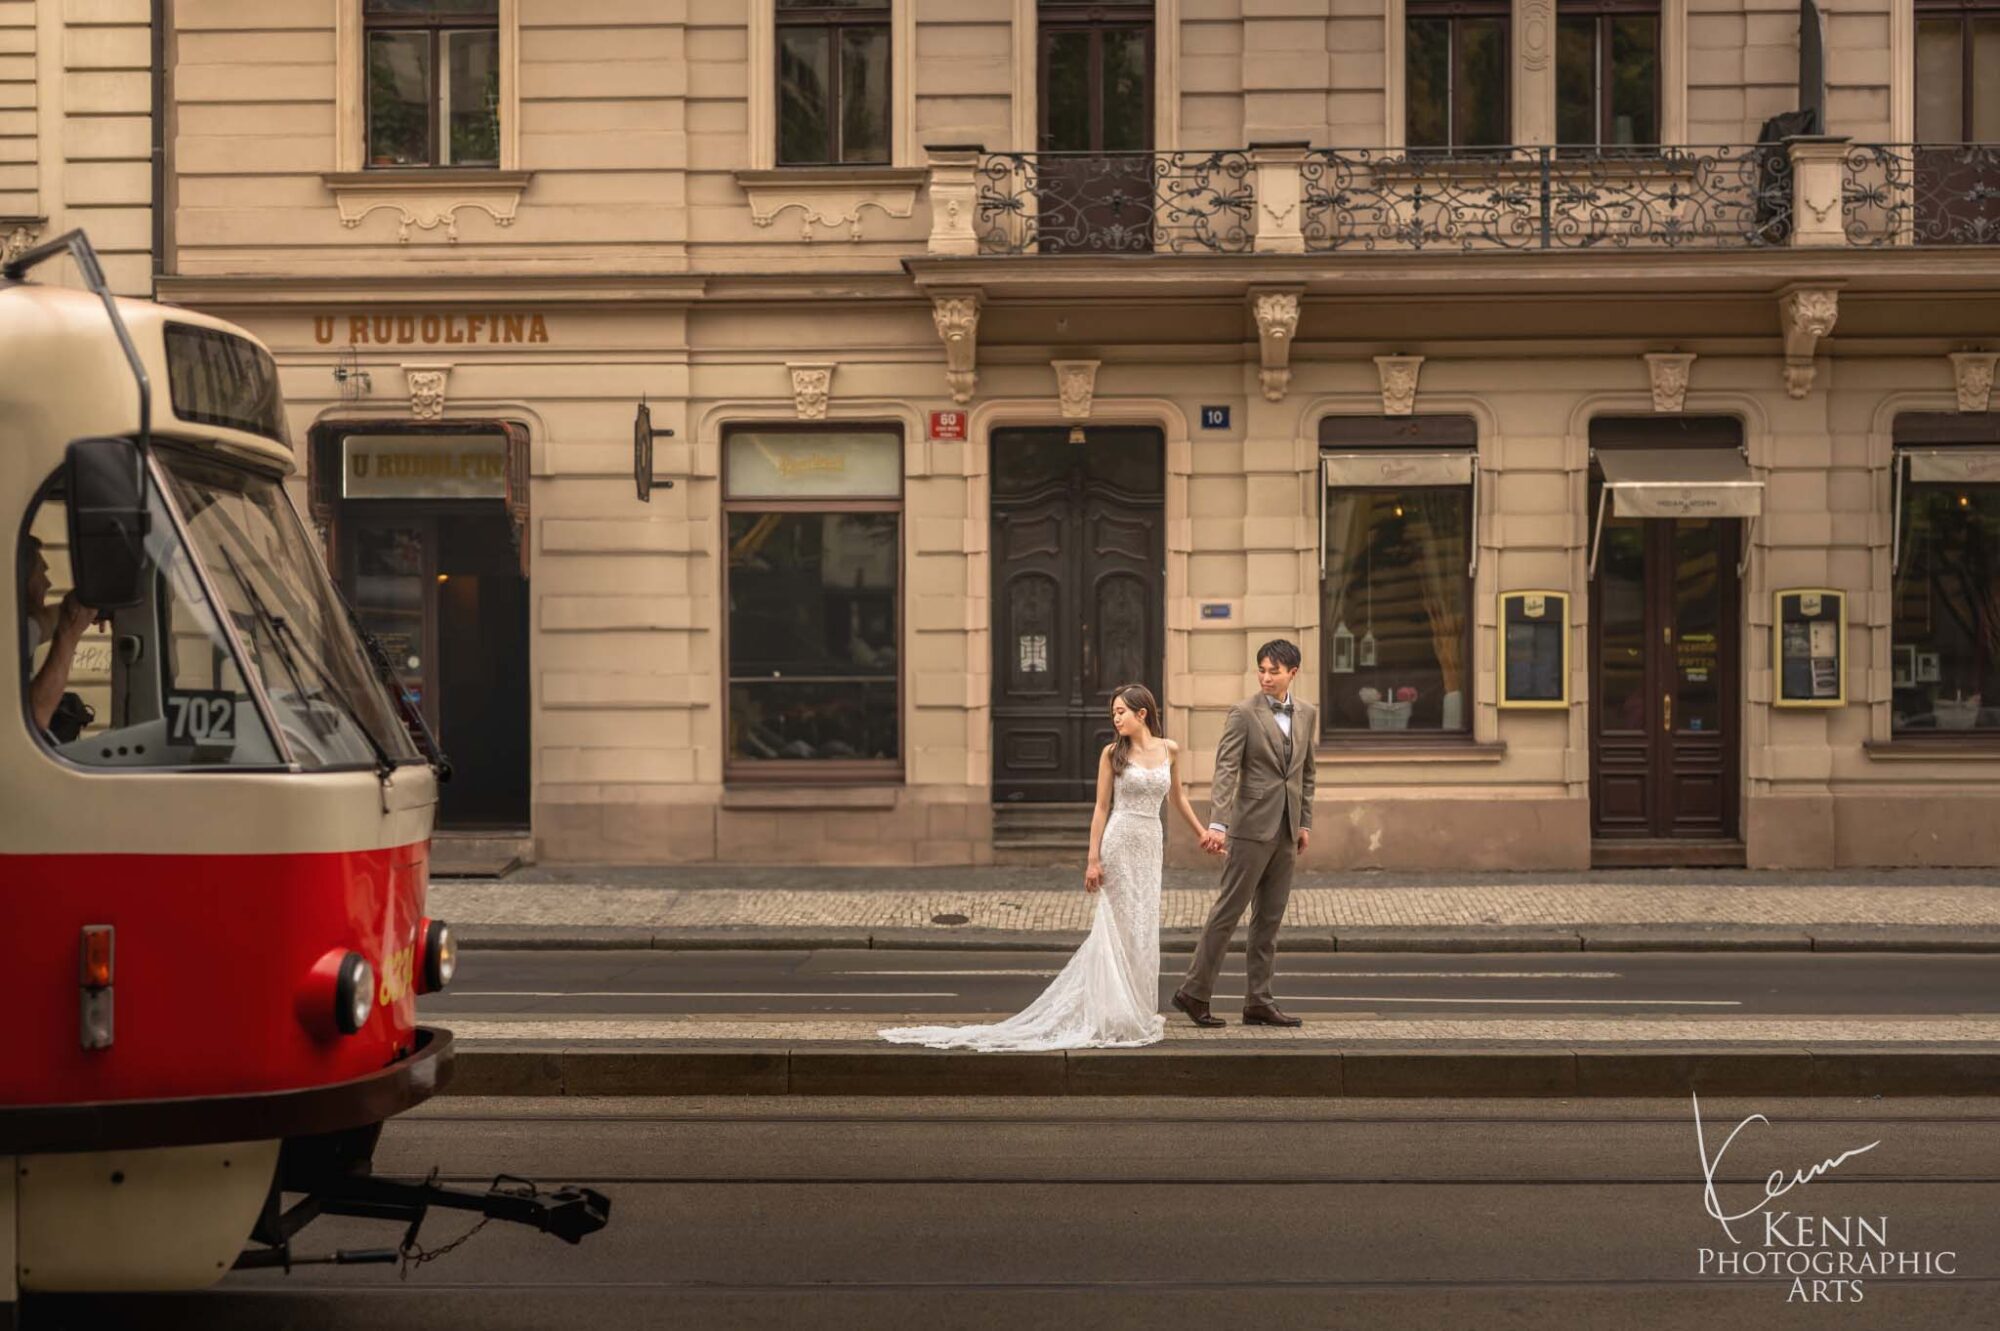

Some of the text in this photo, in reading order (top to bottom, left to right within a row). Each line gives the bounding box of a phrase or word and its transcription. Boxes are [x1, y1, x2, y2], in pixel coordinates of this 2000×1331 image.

[314, 313, 549, 344] U RUDOLFINA
[940, 413, 957, 426] 60
[1208, 410, 1223, 424] 10
[352, 454, 370, 478] U
[168, 697, 233, 739] 702
